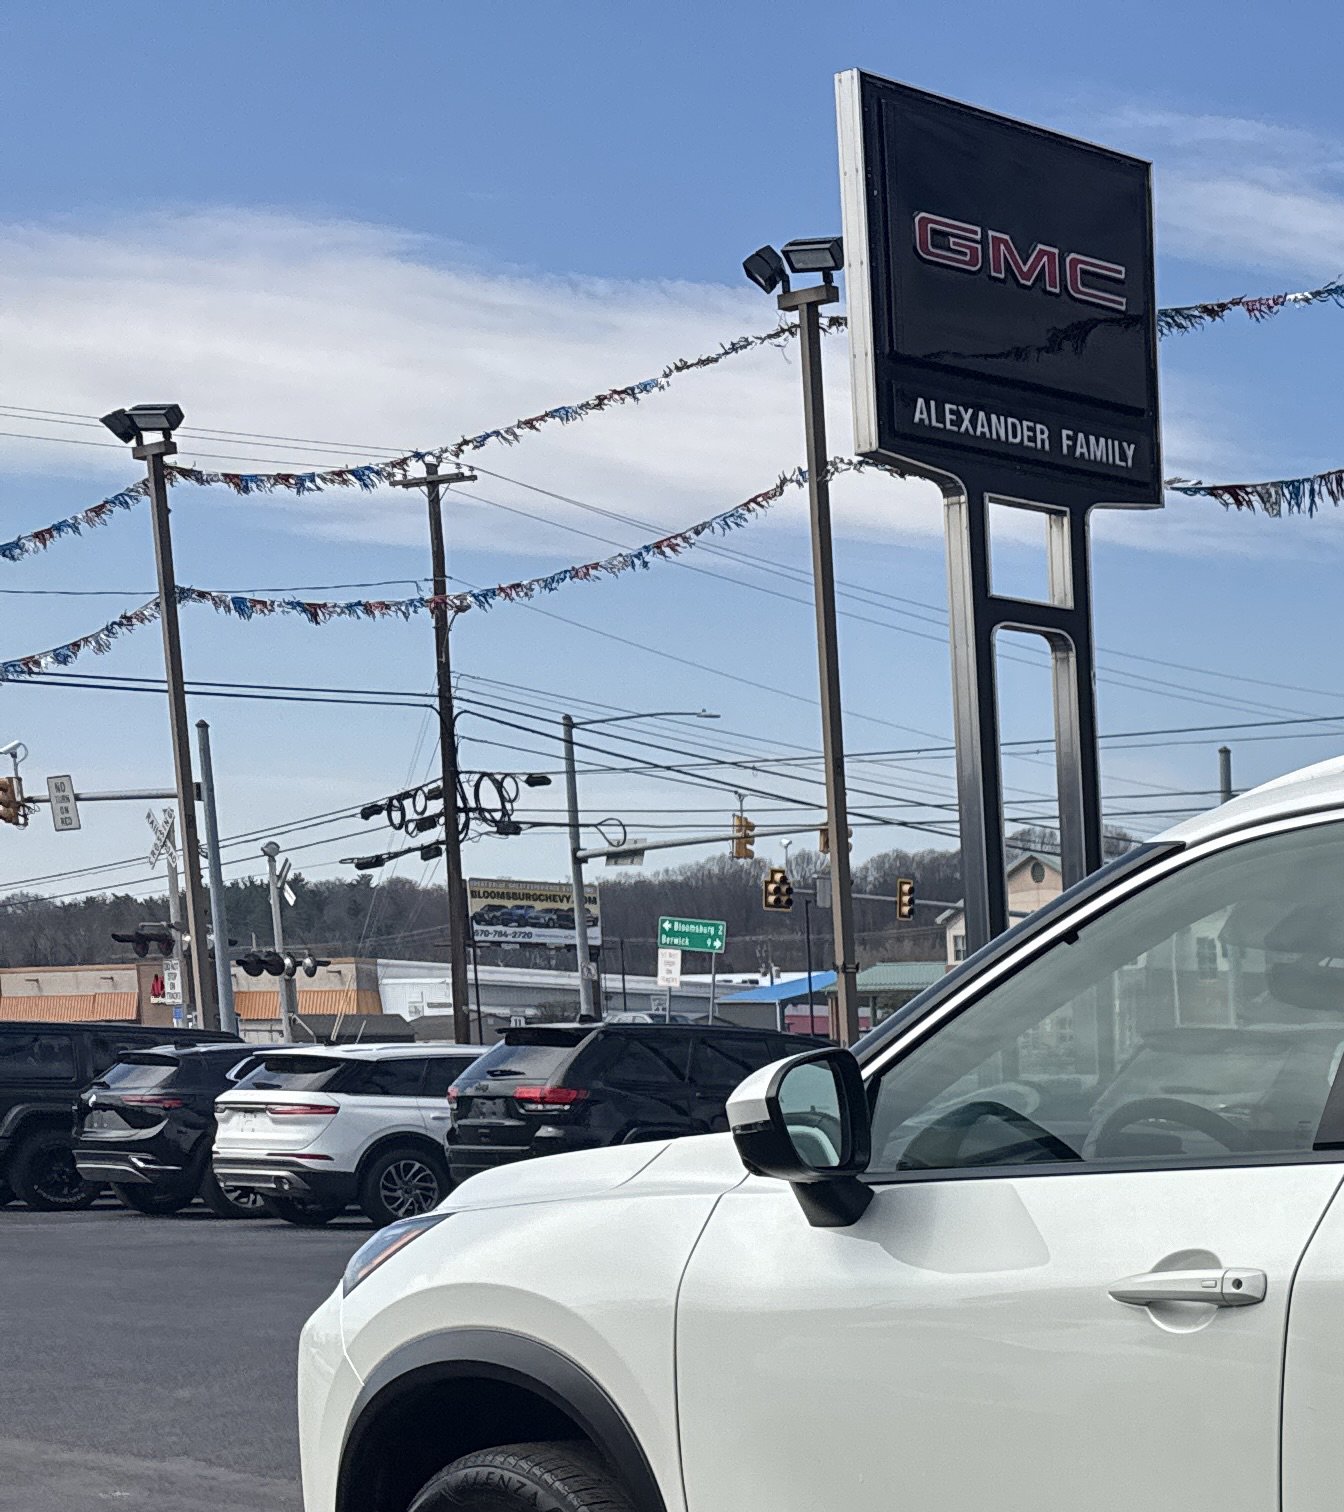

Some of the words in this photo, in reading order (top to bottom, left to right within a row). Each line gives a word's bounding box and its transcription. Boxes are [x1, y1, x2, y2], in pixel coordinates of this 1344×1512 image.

[914, 212, 1127, 311] GMC
[913, 397, 1050, 452] ALEXANDER
[1061, 428, 1136, 468] FAMILY
[54, 781, 66, 793] NO
[470, 889, 598, 905] BLOOMSBURGCHEVY.OM
[673, 921, 715, 936] Bloomsburg
[717, 925, 724, 935] 2
[661, 933, 690, 946] Berwick
